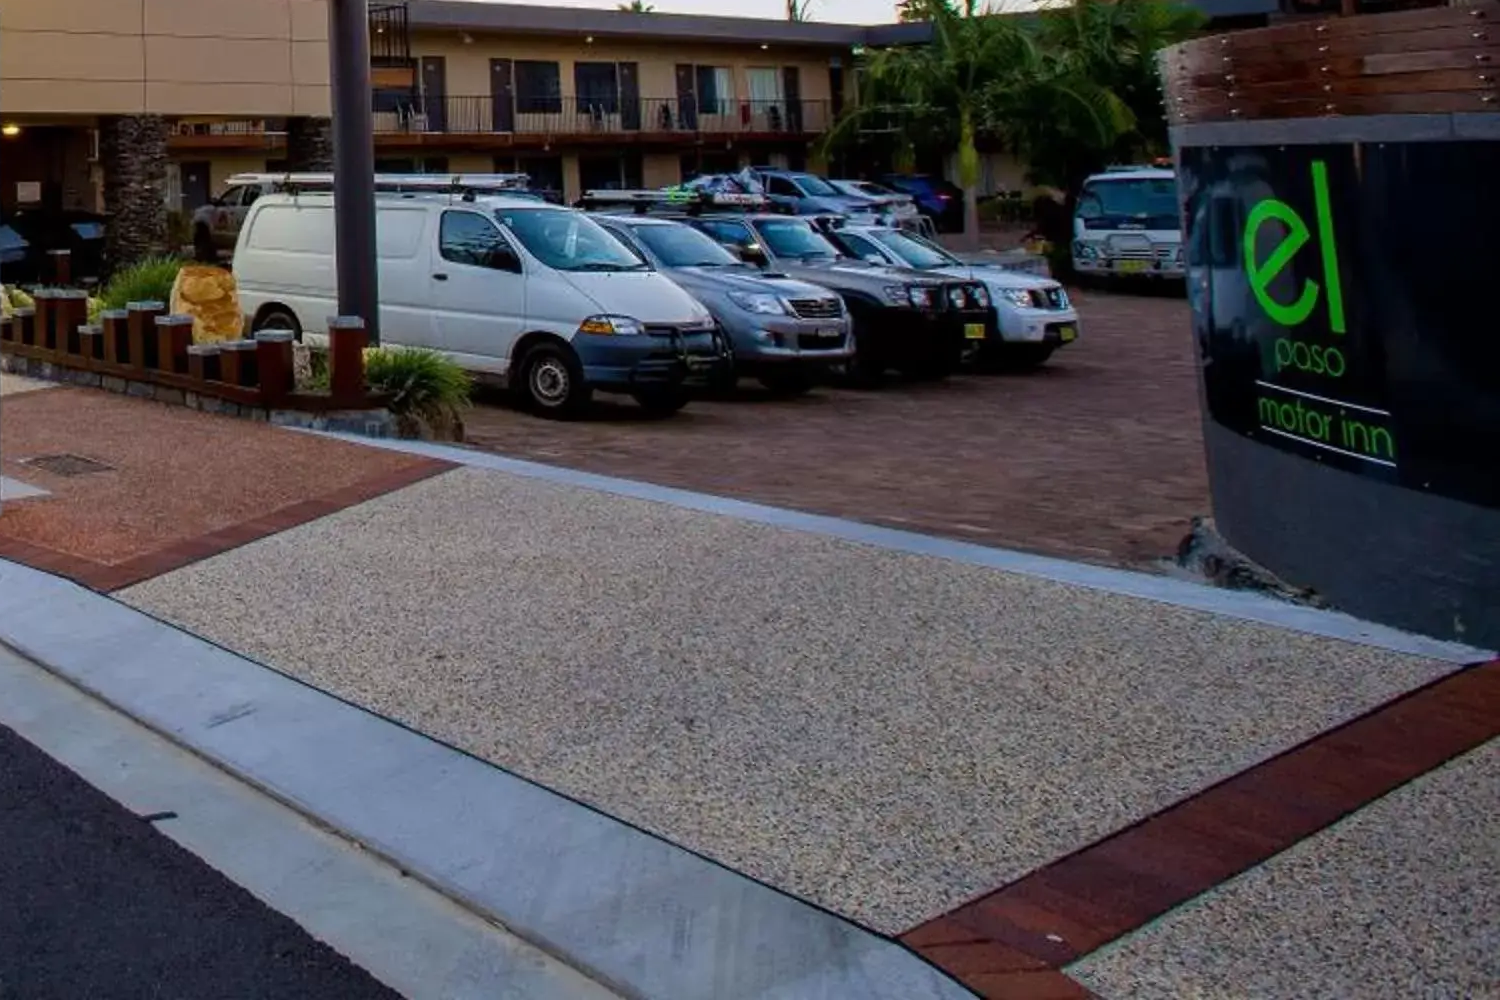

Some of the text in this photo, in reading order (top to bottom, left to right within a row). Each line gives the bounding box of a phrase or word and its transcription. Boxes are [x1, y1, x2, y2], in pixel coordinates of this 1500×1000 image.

[1244, 160, 1346, 334] el
[1275, 338, 1345, 377] paso
[1258, 398, 1394, 458] motor inn
